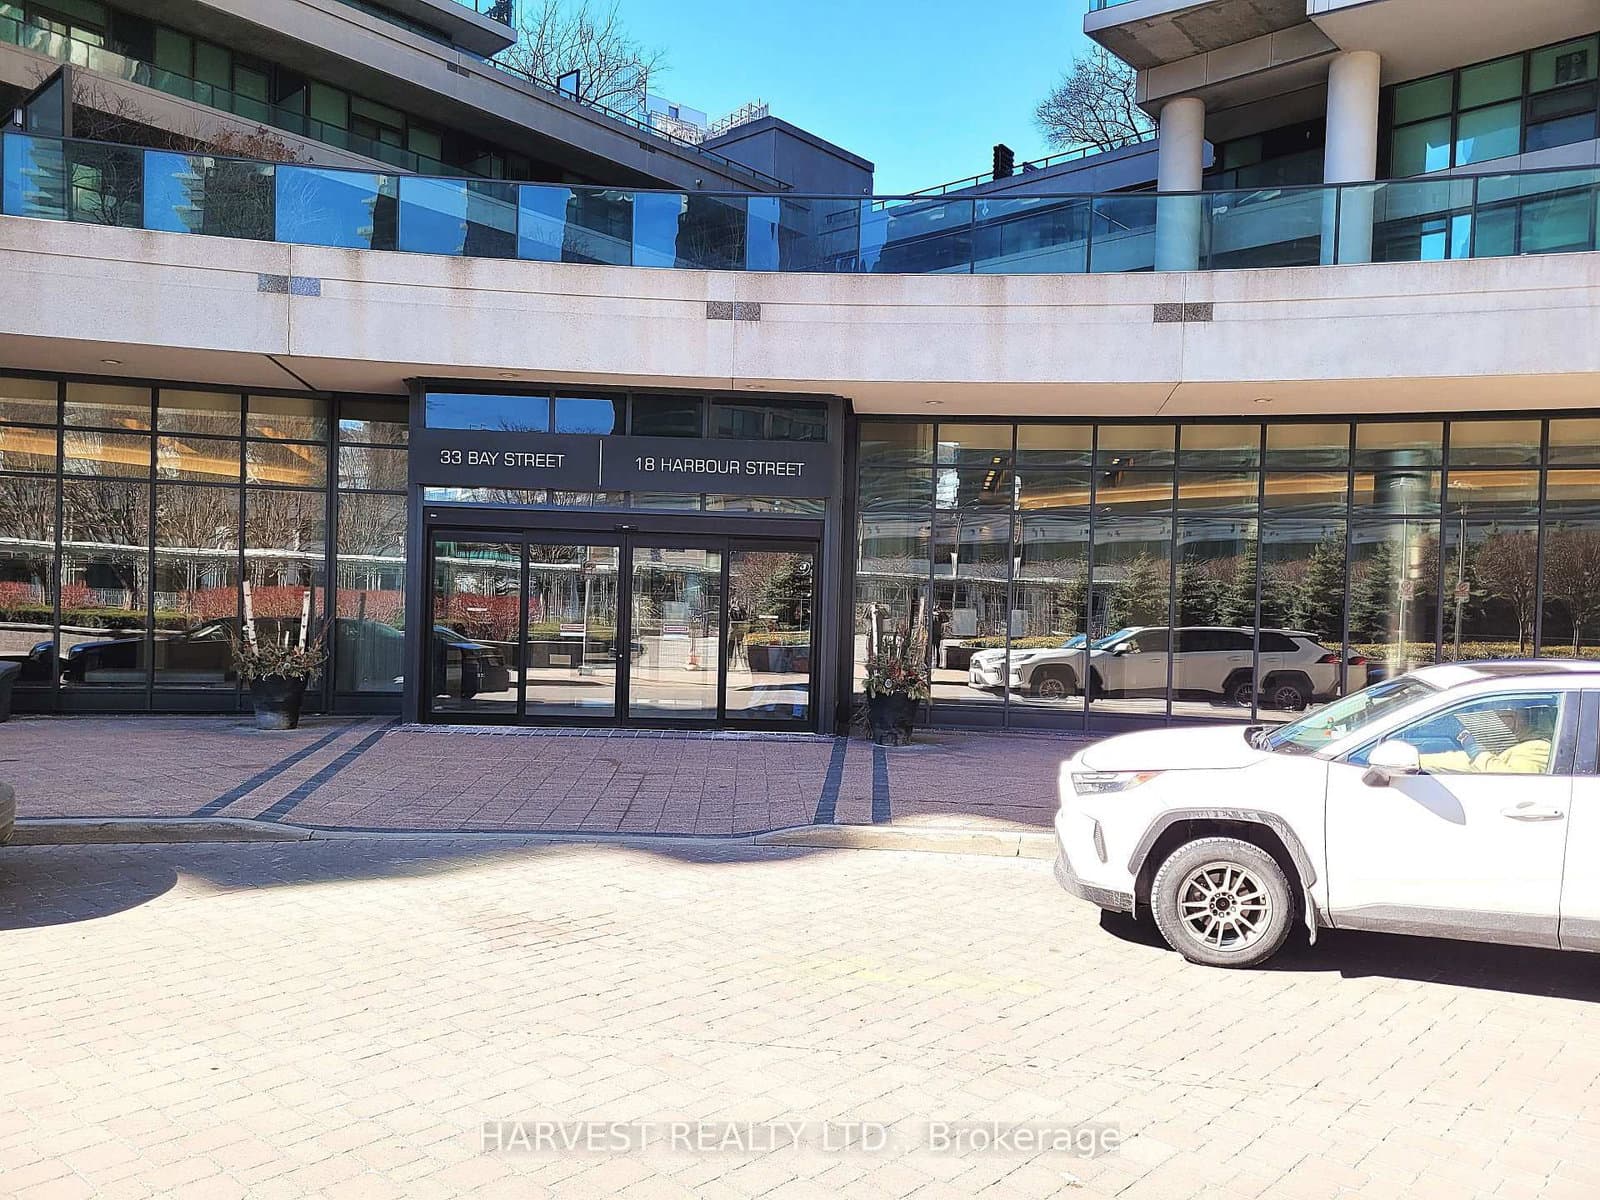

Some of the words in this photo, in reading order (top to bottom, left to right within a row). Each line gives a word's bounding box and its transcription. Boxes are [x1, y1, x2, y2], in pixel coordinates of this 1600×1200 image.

[440, 450, 462, 464] 33
[468, 451, 499, 465] BAY
[504, 452, 565, 468] STREET
[635, 457, 655, 471] 18
[661, 458, 740, 474] HARBOUR
[745, 461, 805, 476] STREET
